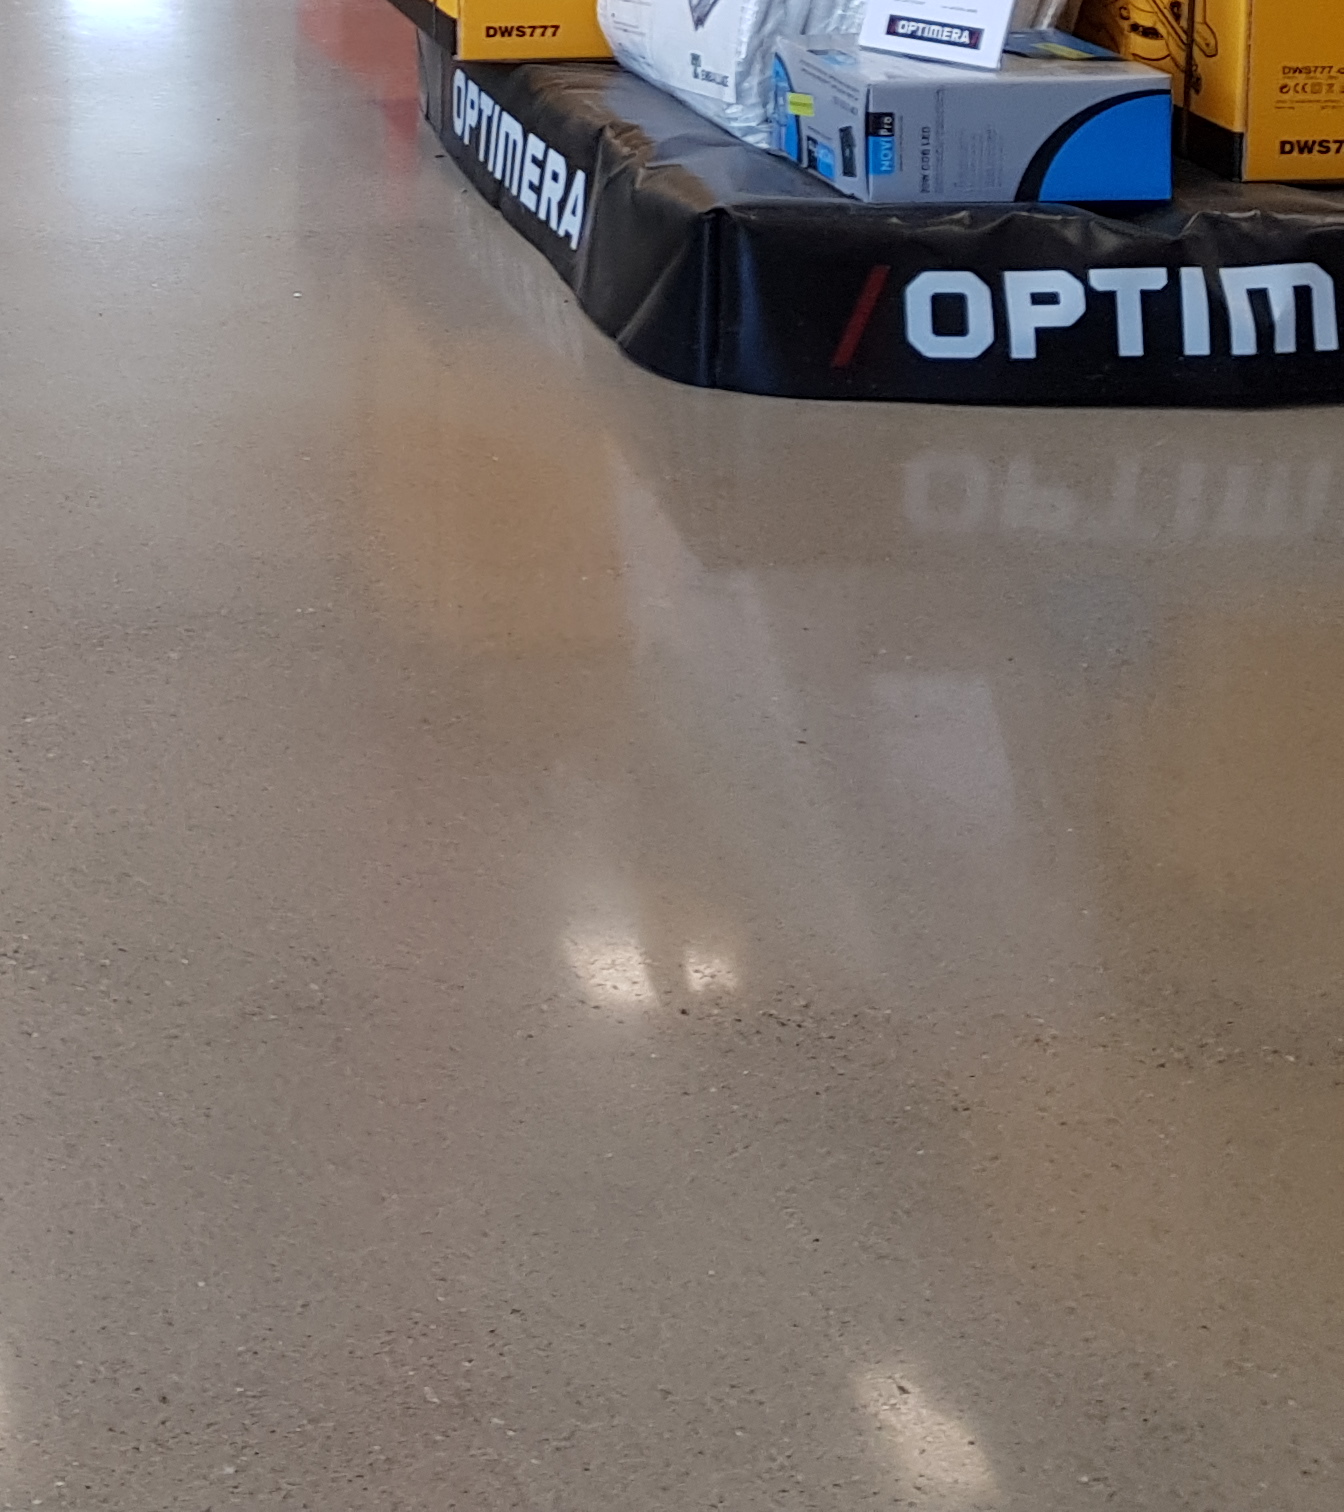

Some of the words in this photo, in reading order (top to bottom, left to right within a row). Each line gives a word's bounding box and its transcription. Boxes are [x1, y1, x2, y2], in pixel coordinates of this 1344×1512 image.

[485, 25, 561, 39] DWS777
[896, 19, 970, 45] OPTIMERA
[451, 67, 589, 253] OPTIMERA
[1279, 139, 1344, 155] DWS7
[904, 261, 1341, 360] OPTIM
